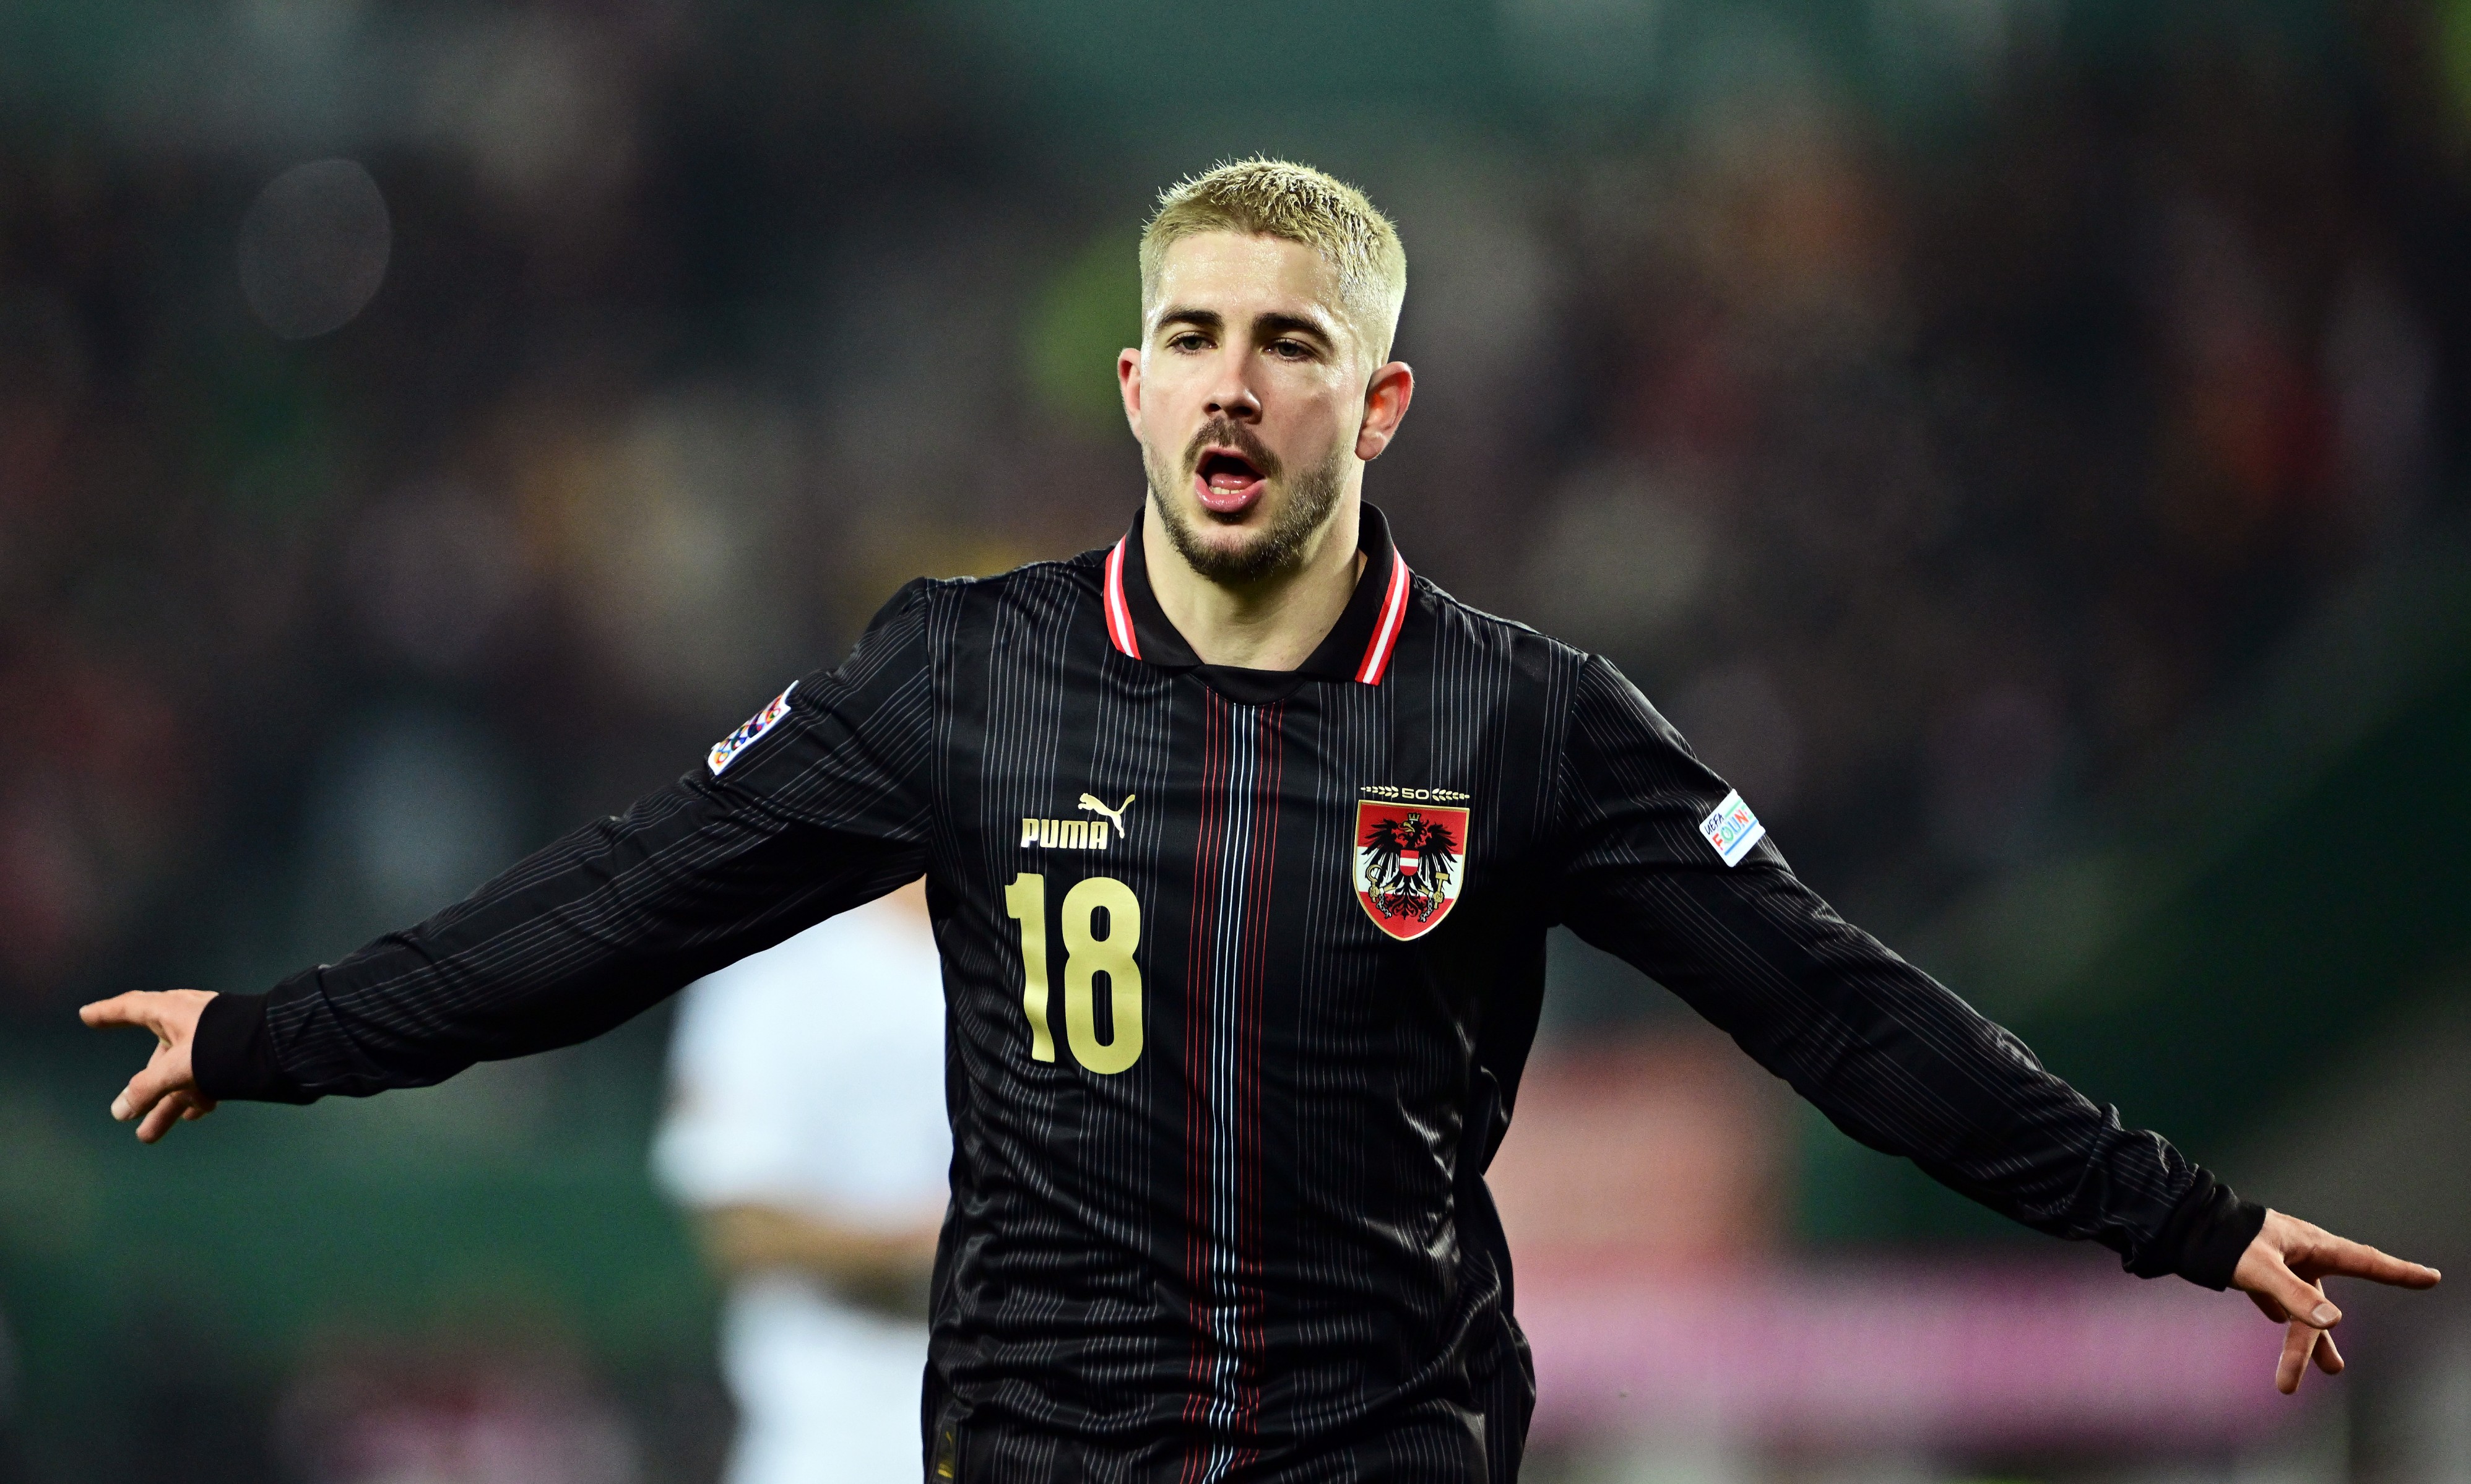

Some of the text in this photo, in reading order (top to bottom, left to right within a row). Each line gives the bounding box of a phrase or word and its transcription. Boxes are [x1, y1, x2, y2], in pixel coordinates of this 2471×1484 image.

[1401, 788, 1430, 800] 50
[1021, 817, 1109, 850] PUMA
[1704, 813, 1725, 835] UEFA
[1005, 873, 1143, 1075] 18
